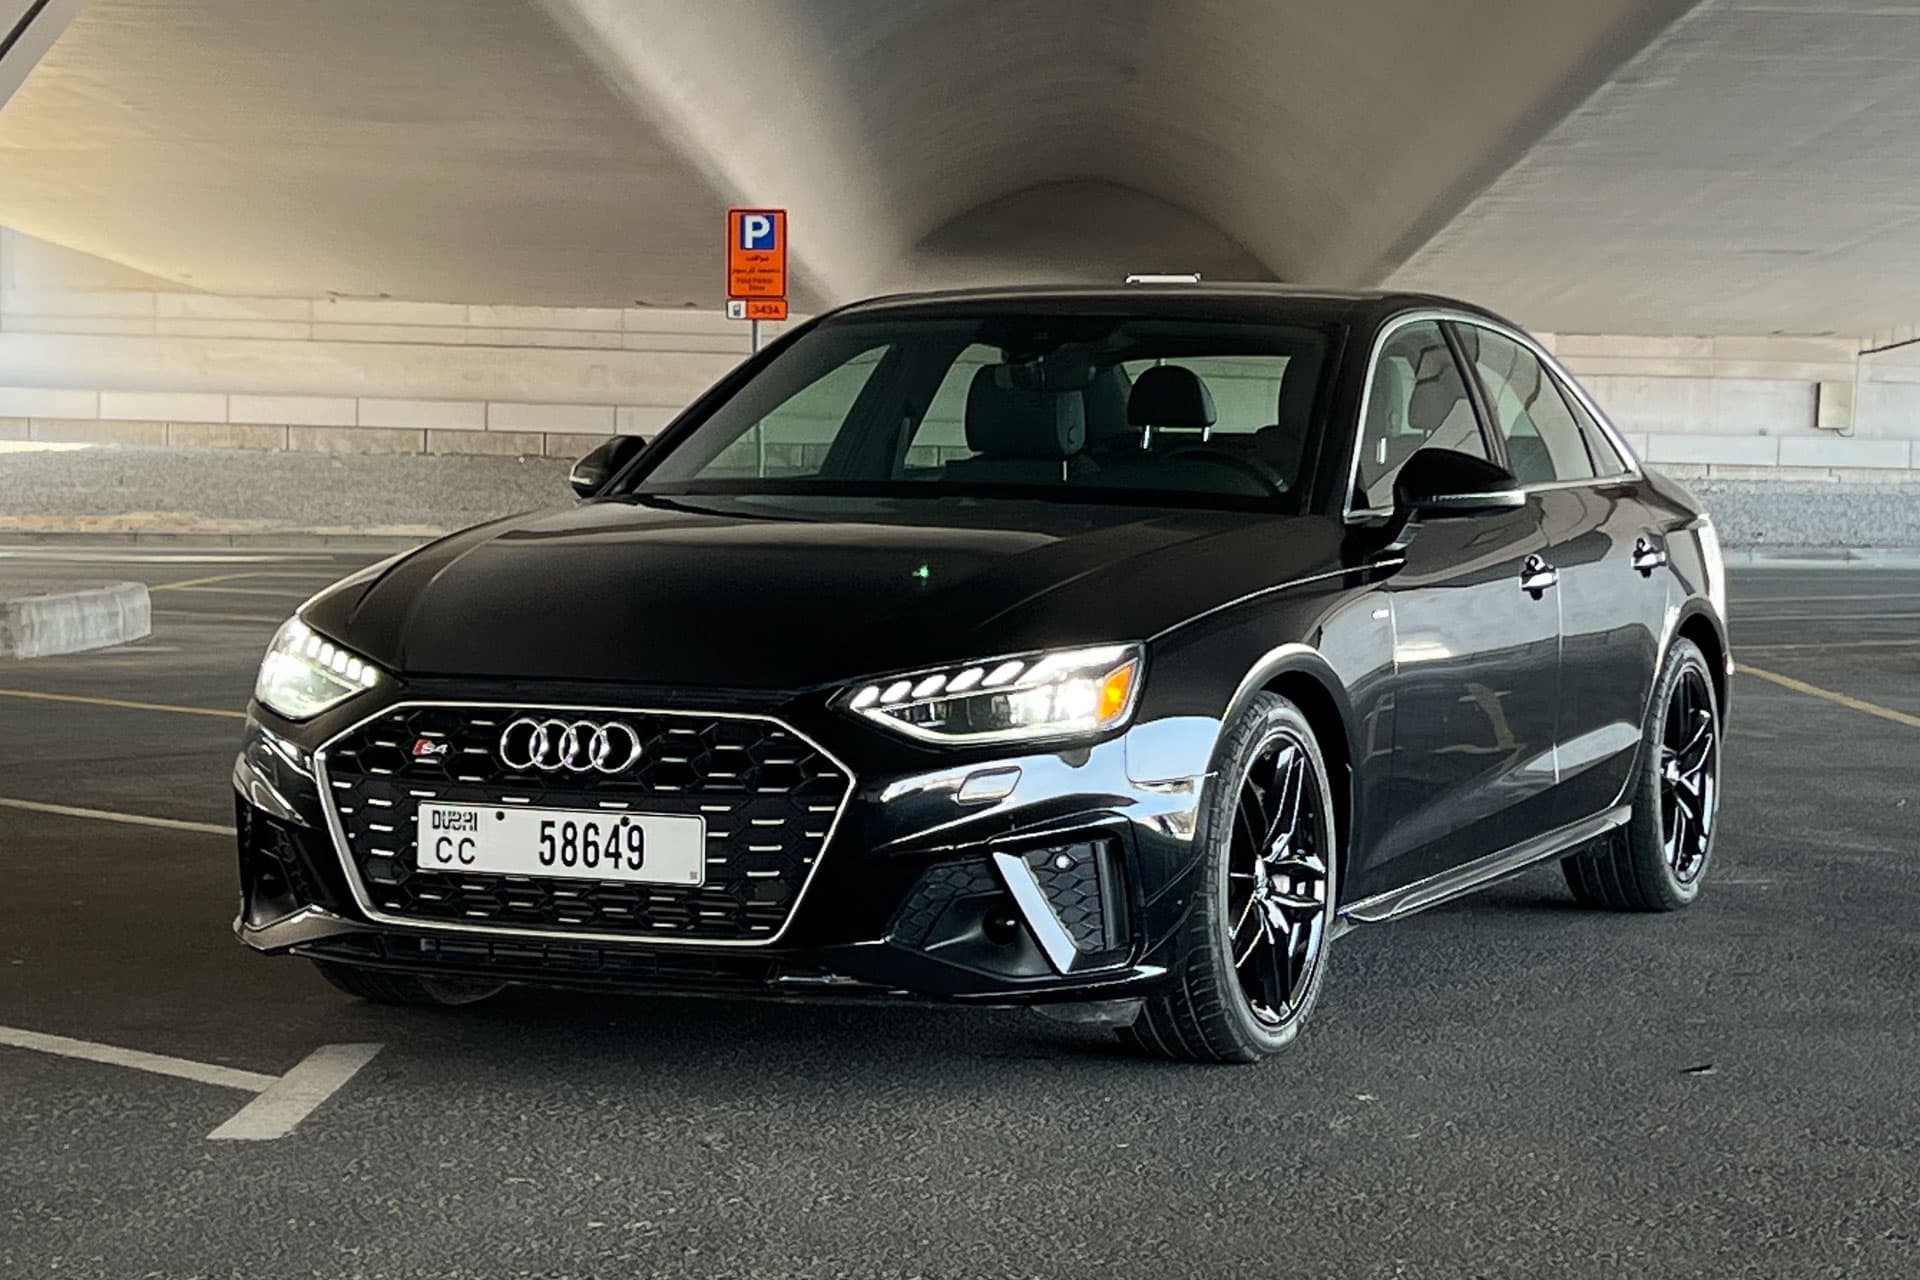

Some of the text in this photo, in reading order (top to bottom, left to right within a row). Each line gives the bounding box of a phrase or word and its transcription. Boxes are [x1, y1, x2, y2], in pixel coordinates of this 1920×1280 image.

[744, 214, 770, 249] P
[418, 739, 448, 755] S4
[436, 820, 645, 871] CC 58649
